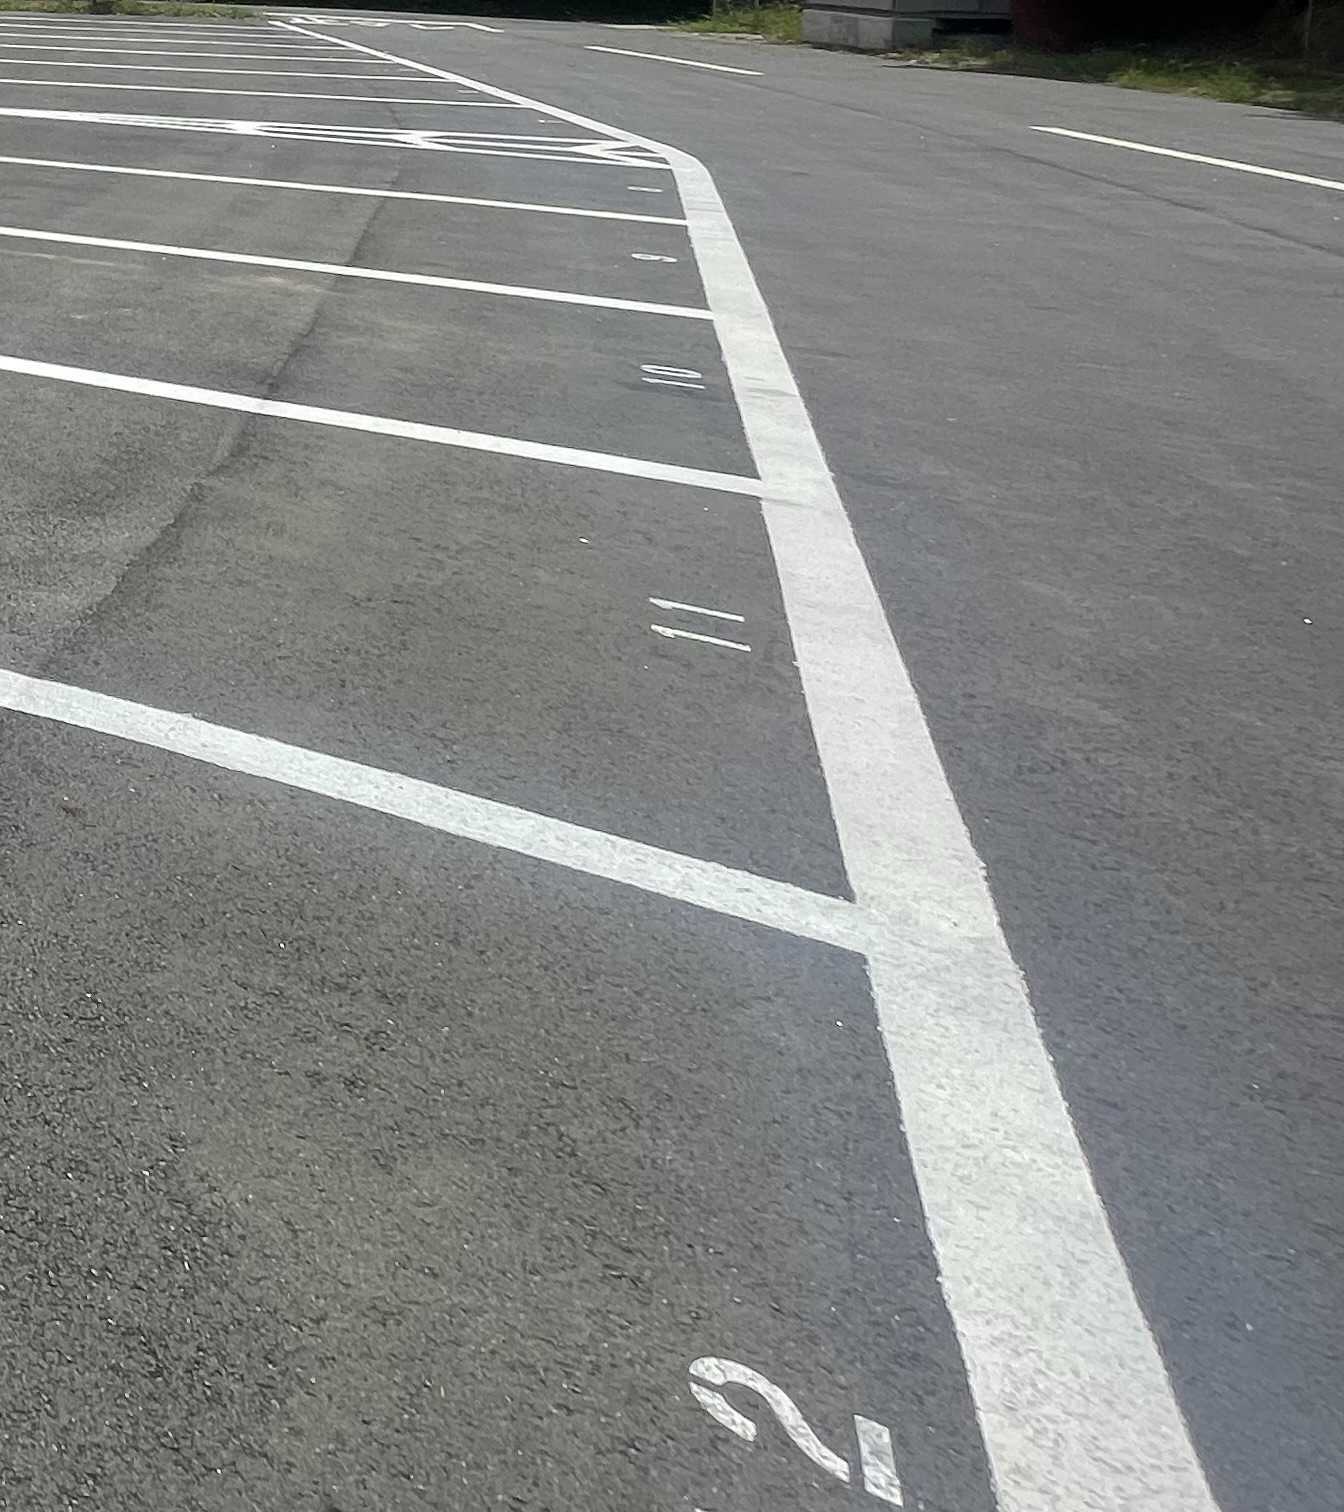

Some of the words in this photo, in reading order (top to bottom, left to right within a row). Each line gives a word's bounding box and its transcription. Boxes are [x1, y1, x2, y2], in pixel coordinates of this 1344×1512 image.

[640, 363, 706, 390] 10
[649, 596, 752, 653] 11
[688, 1355, 905, 1508] 2
